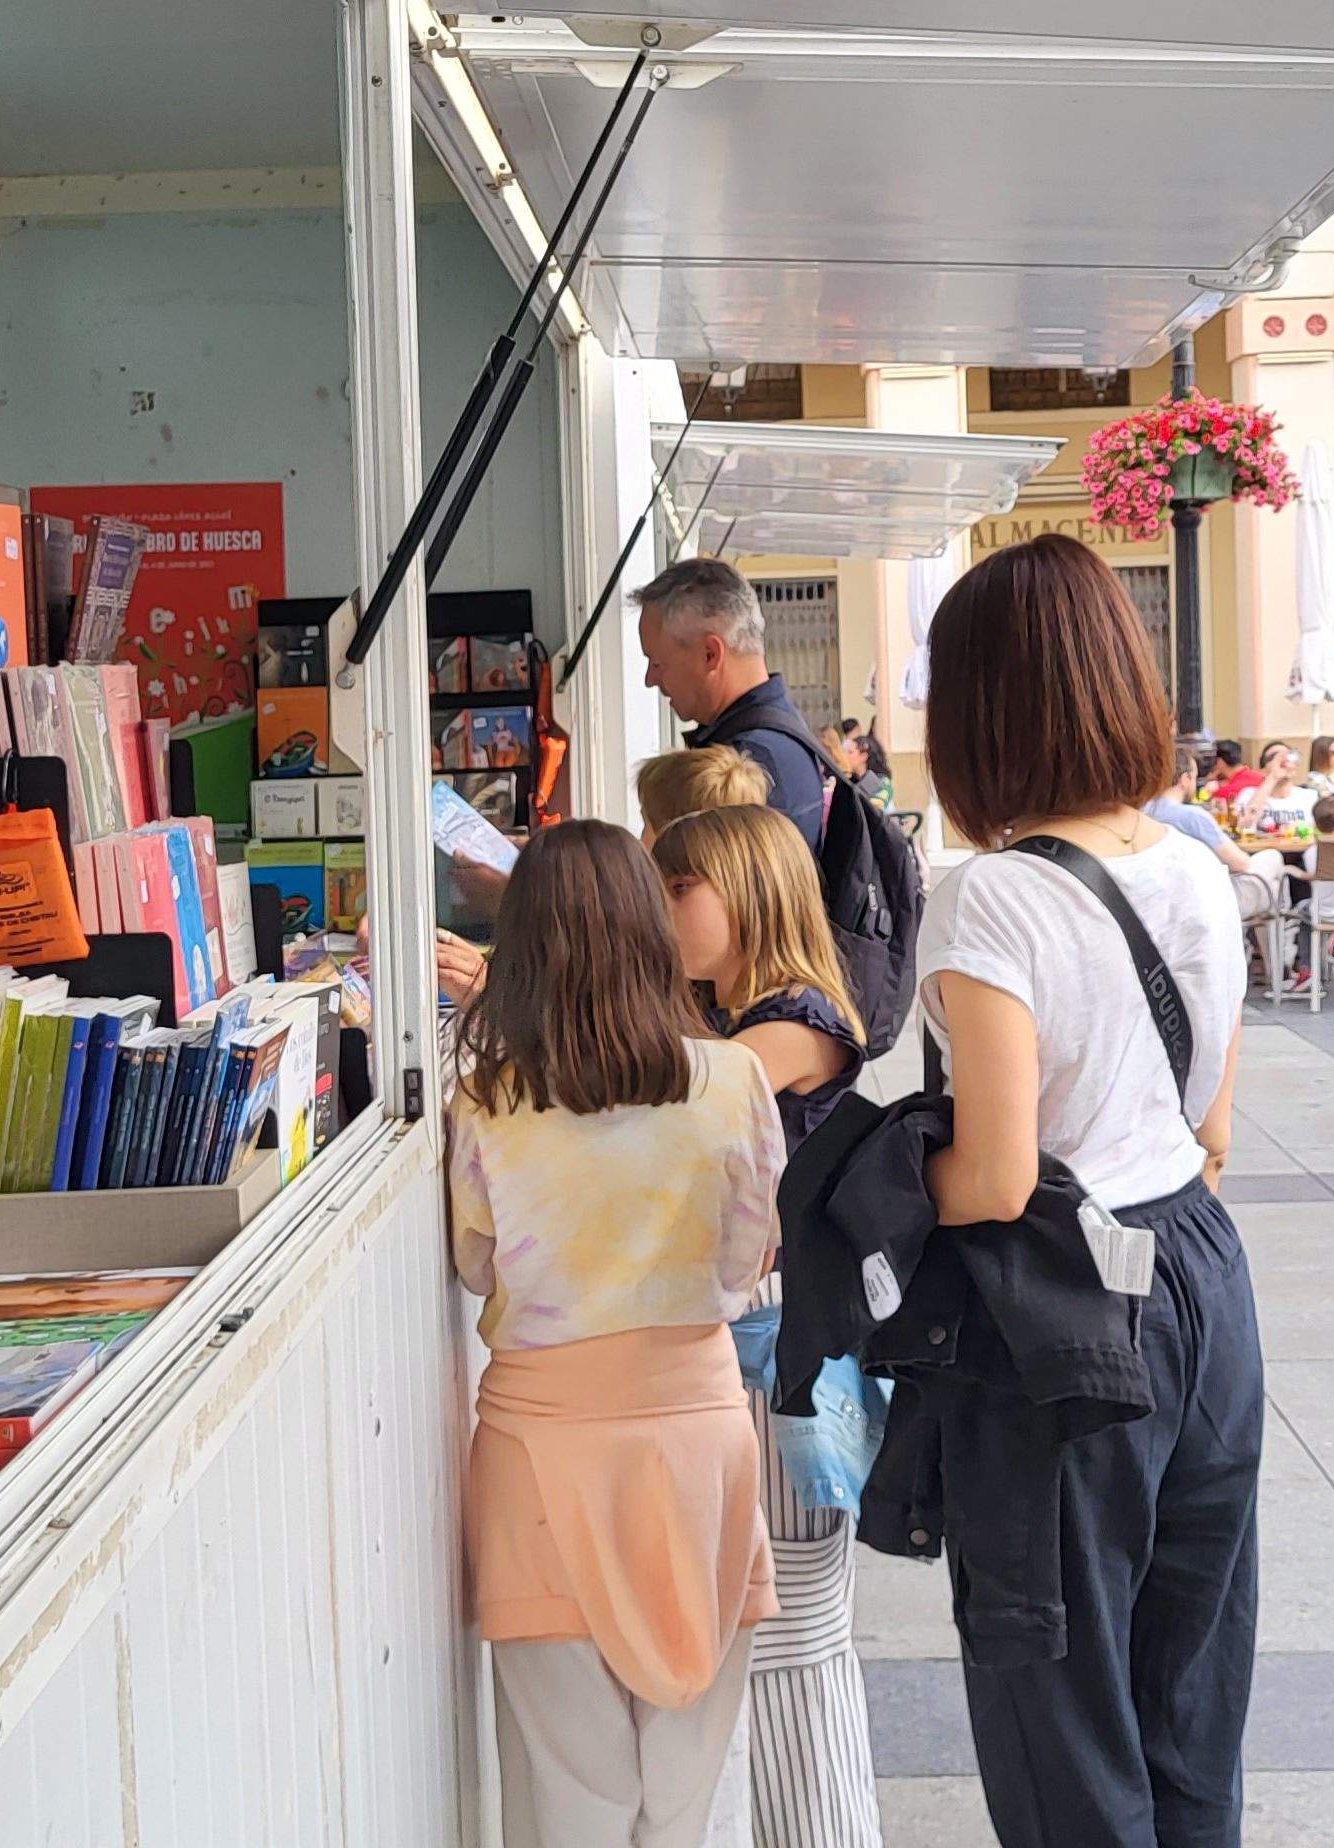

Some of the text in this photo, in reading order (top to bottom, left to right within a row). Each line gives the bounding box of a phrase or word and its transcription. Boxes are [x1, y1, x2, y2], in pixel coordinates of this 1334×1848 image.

[146, 530, 262, 553] BRO DE HUESCA
